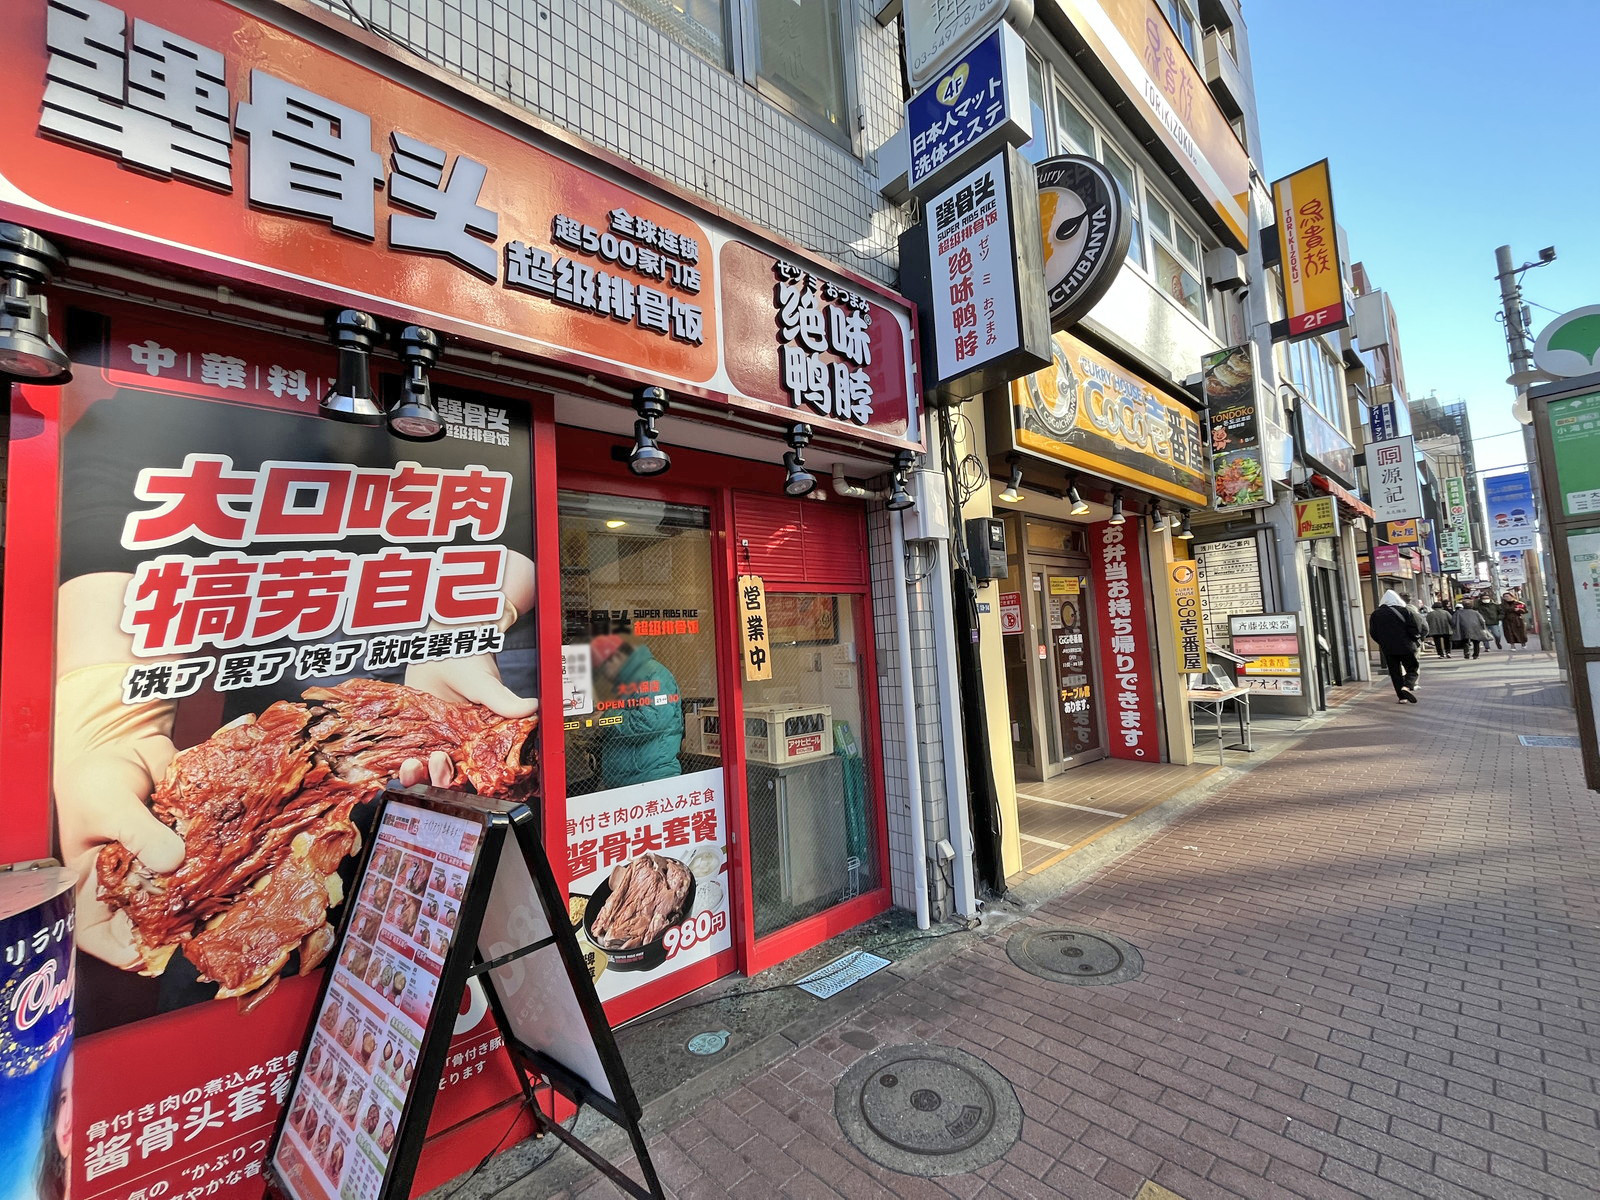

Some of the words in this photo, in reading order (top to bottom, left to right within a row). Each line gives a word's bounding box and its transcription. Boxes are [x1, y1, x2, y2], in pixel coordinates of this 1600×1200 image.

[942, 74, 964, 102] 4F
[912, 77, 1002, 157] 日本人マット
[914, 101, 1003, 179] 洗体エステ
[609, 207, 699, 264] 全球连锁
[937, 222, 960, 242] SUPER
[961, 210, 979, 226] RIBS
[980, 199, 997, 216] RICE
[938, 209, 998, 256] 超级排骨饭
[1284, 208, 1299, 281] TORIKIZOKU
[553, 213, 700, 293] 超500家门店
[503, 240, 703, 345] 超级排骨饭
[948, 247, 979, 362] 绝味鸭脖
[779, 282, 872, 366] 绝味
[983, 297, 997, 345] おつまみ
[1303, 310, 1328, 329] 2F
[128, 340, 337, 402] 中華料
[783, 344, 874, 425] 鸭脖
[1211, 407, 1254, 423] TONDOKO
[124, 456, 510, 546] 大口吃肉
[1382, 467, 1404, 503] 源記
[125, 548, 505, 653] 犒劳自己
[634, 609, 661, 618] SUPER
[663, 609, 681, 618] RIBS
[682, 609, 698, 617] RICE
[634, 620, 699, 636] 超级排骨饭
[743, 585, 767, 672] 営業中
[1102, 526, 1145, 756] お弁当お持ち帰りできます。
[126, 661, 211, 701] 饿了
[218, 648, 294, 690] 累了
[299, 637, 362, 678] 馋了
[1245, 679, 1278, 690] アオイ
[597, 700, 625, 711] OPEN
[788, 737, 821, 749] アサヒビール
[566, 787, 715, 837] 骨付き肉の煮込み定食
[662, 910, 727, 960] 980円
[446, 1035, 505, 1067] 「骨付き豚
[86, 1050, 299, 1140] 骨付き肉の煮込み定食
[181, 1138, 268, 1180] “かぶりつ
